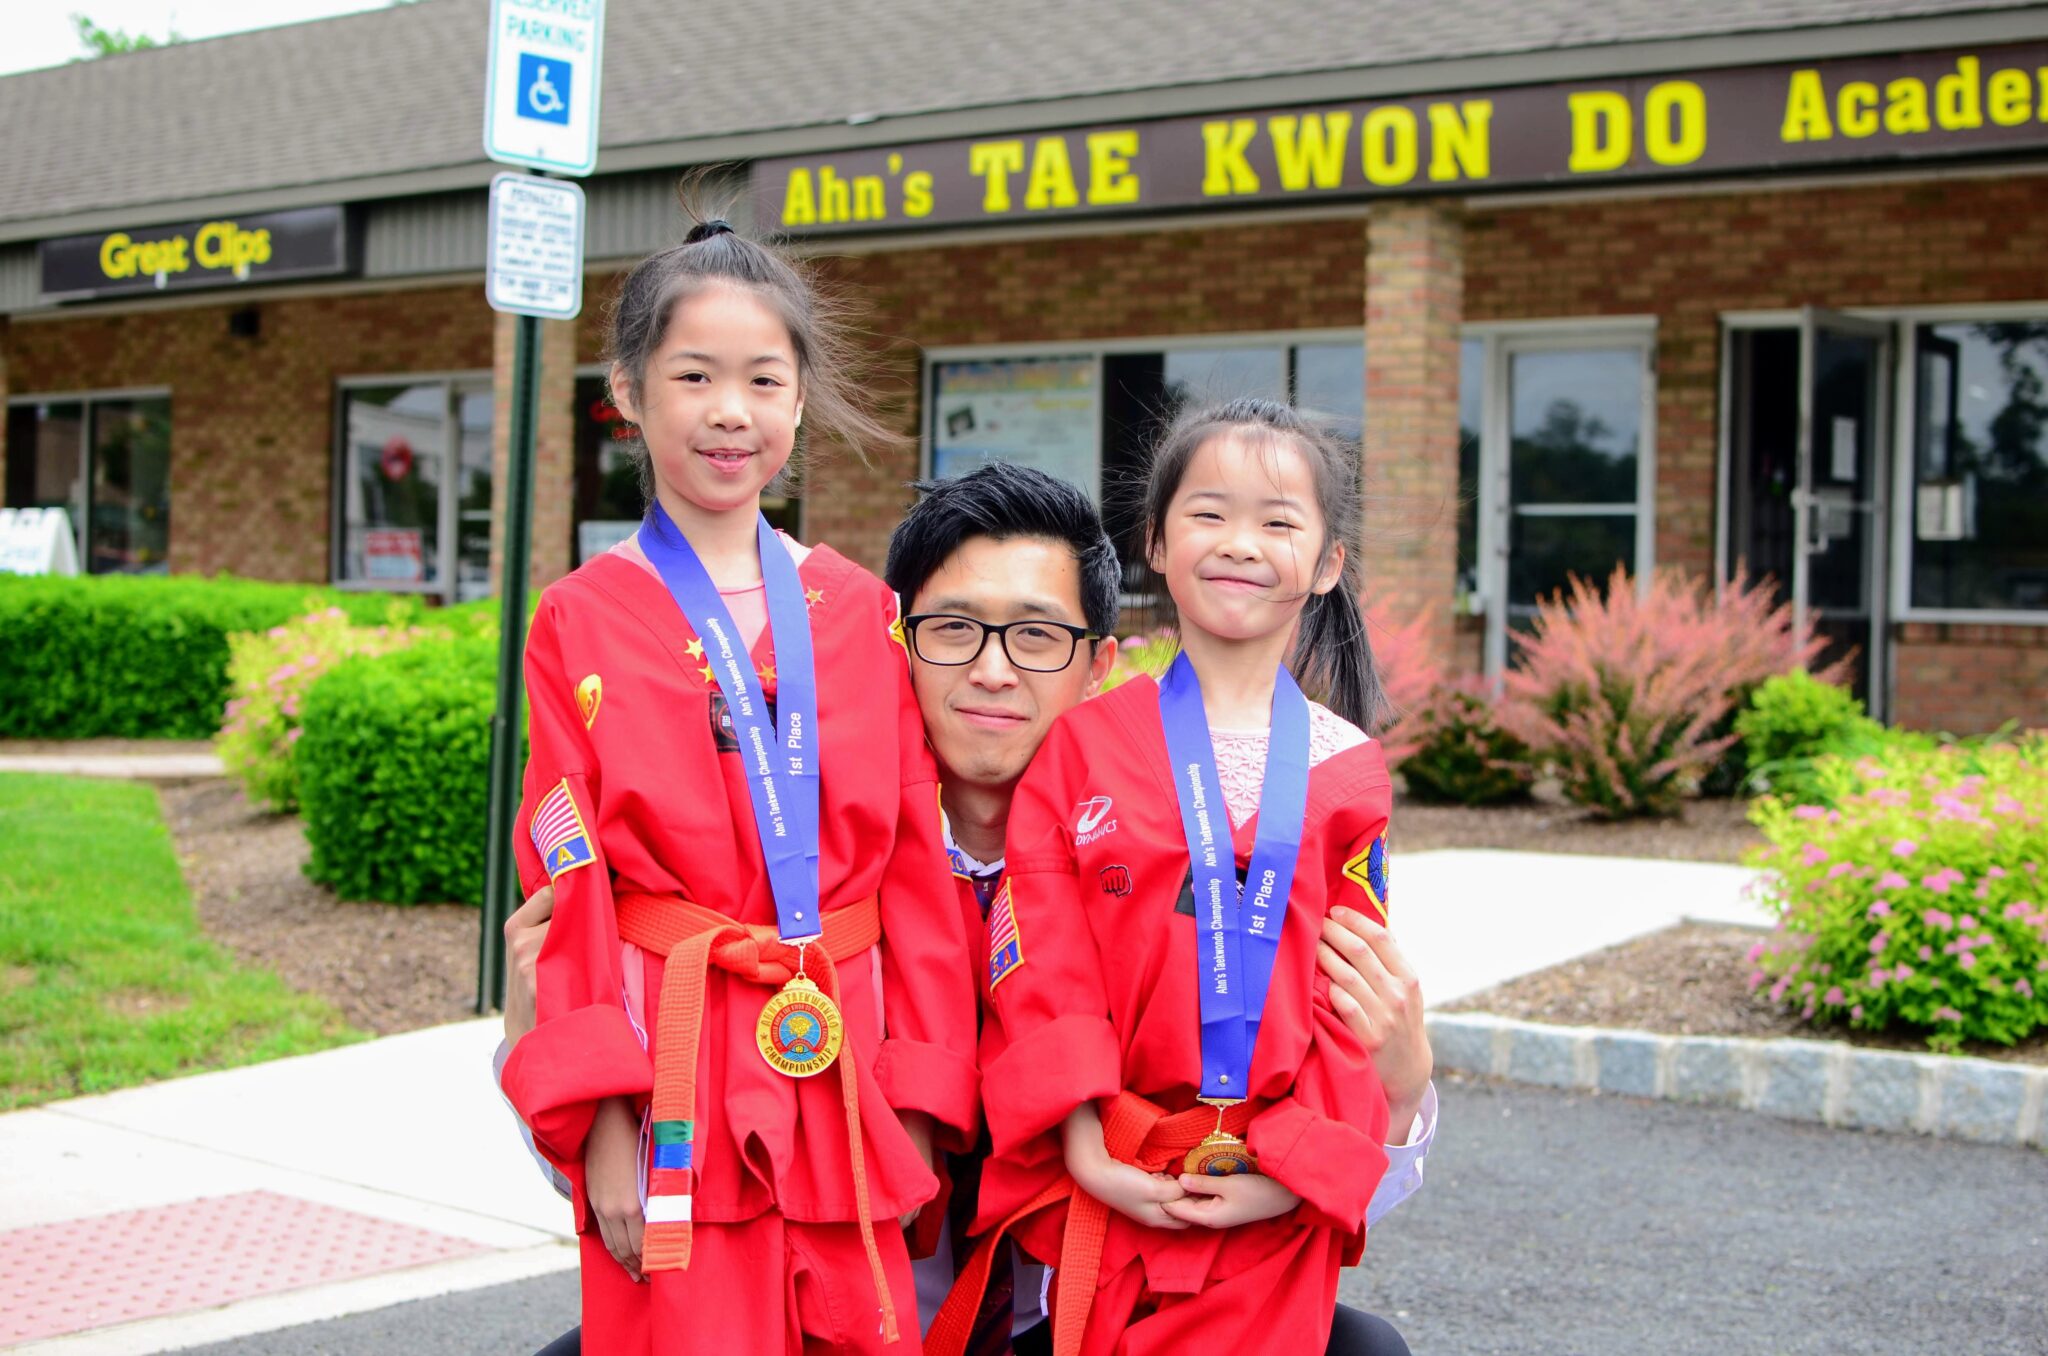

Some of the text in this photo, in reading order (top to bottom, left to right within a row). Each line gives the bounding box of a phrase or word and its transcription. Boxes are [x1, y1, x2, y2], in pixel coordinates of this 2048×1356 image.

[506, 14, 586, 52] PARKING
[782, 153, 934, 227] Ahn's
[969, 130, 1141, 213] TAE
[1202, 100, 1493, 197] KWON
[1567, 79, 1707, 174] DO
[100, 221, 272, 279] Great Clips
[725, 659, 747, 696] Taekwondo
[739, 696, 754, 716] Ahn's
[787, 712, 804, 777] 1st Place
[749, 726, 787, 837] Ahn's Taekwondo Championship
[1187, 763, 1217, 867] Ahn's Taekwondo Championship
[1248, 869, 1276, 935] 1st Place
[1208, 878, 1229, 995] Ahn's Taekwondo Championship
[764, 1045, 834, 1073] CHAMPIONSHIP
